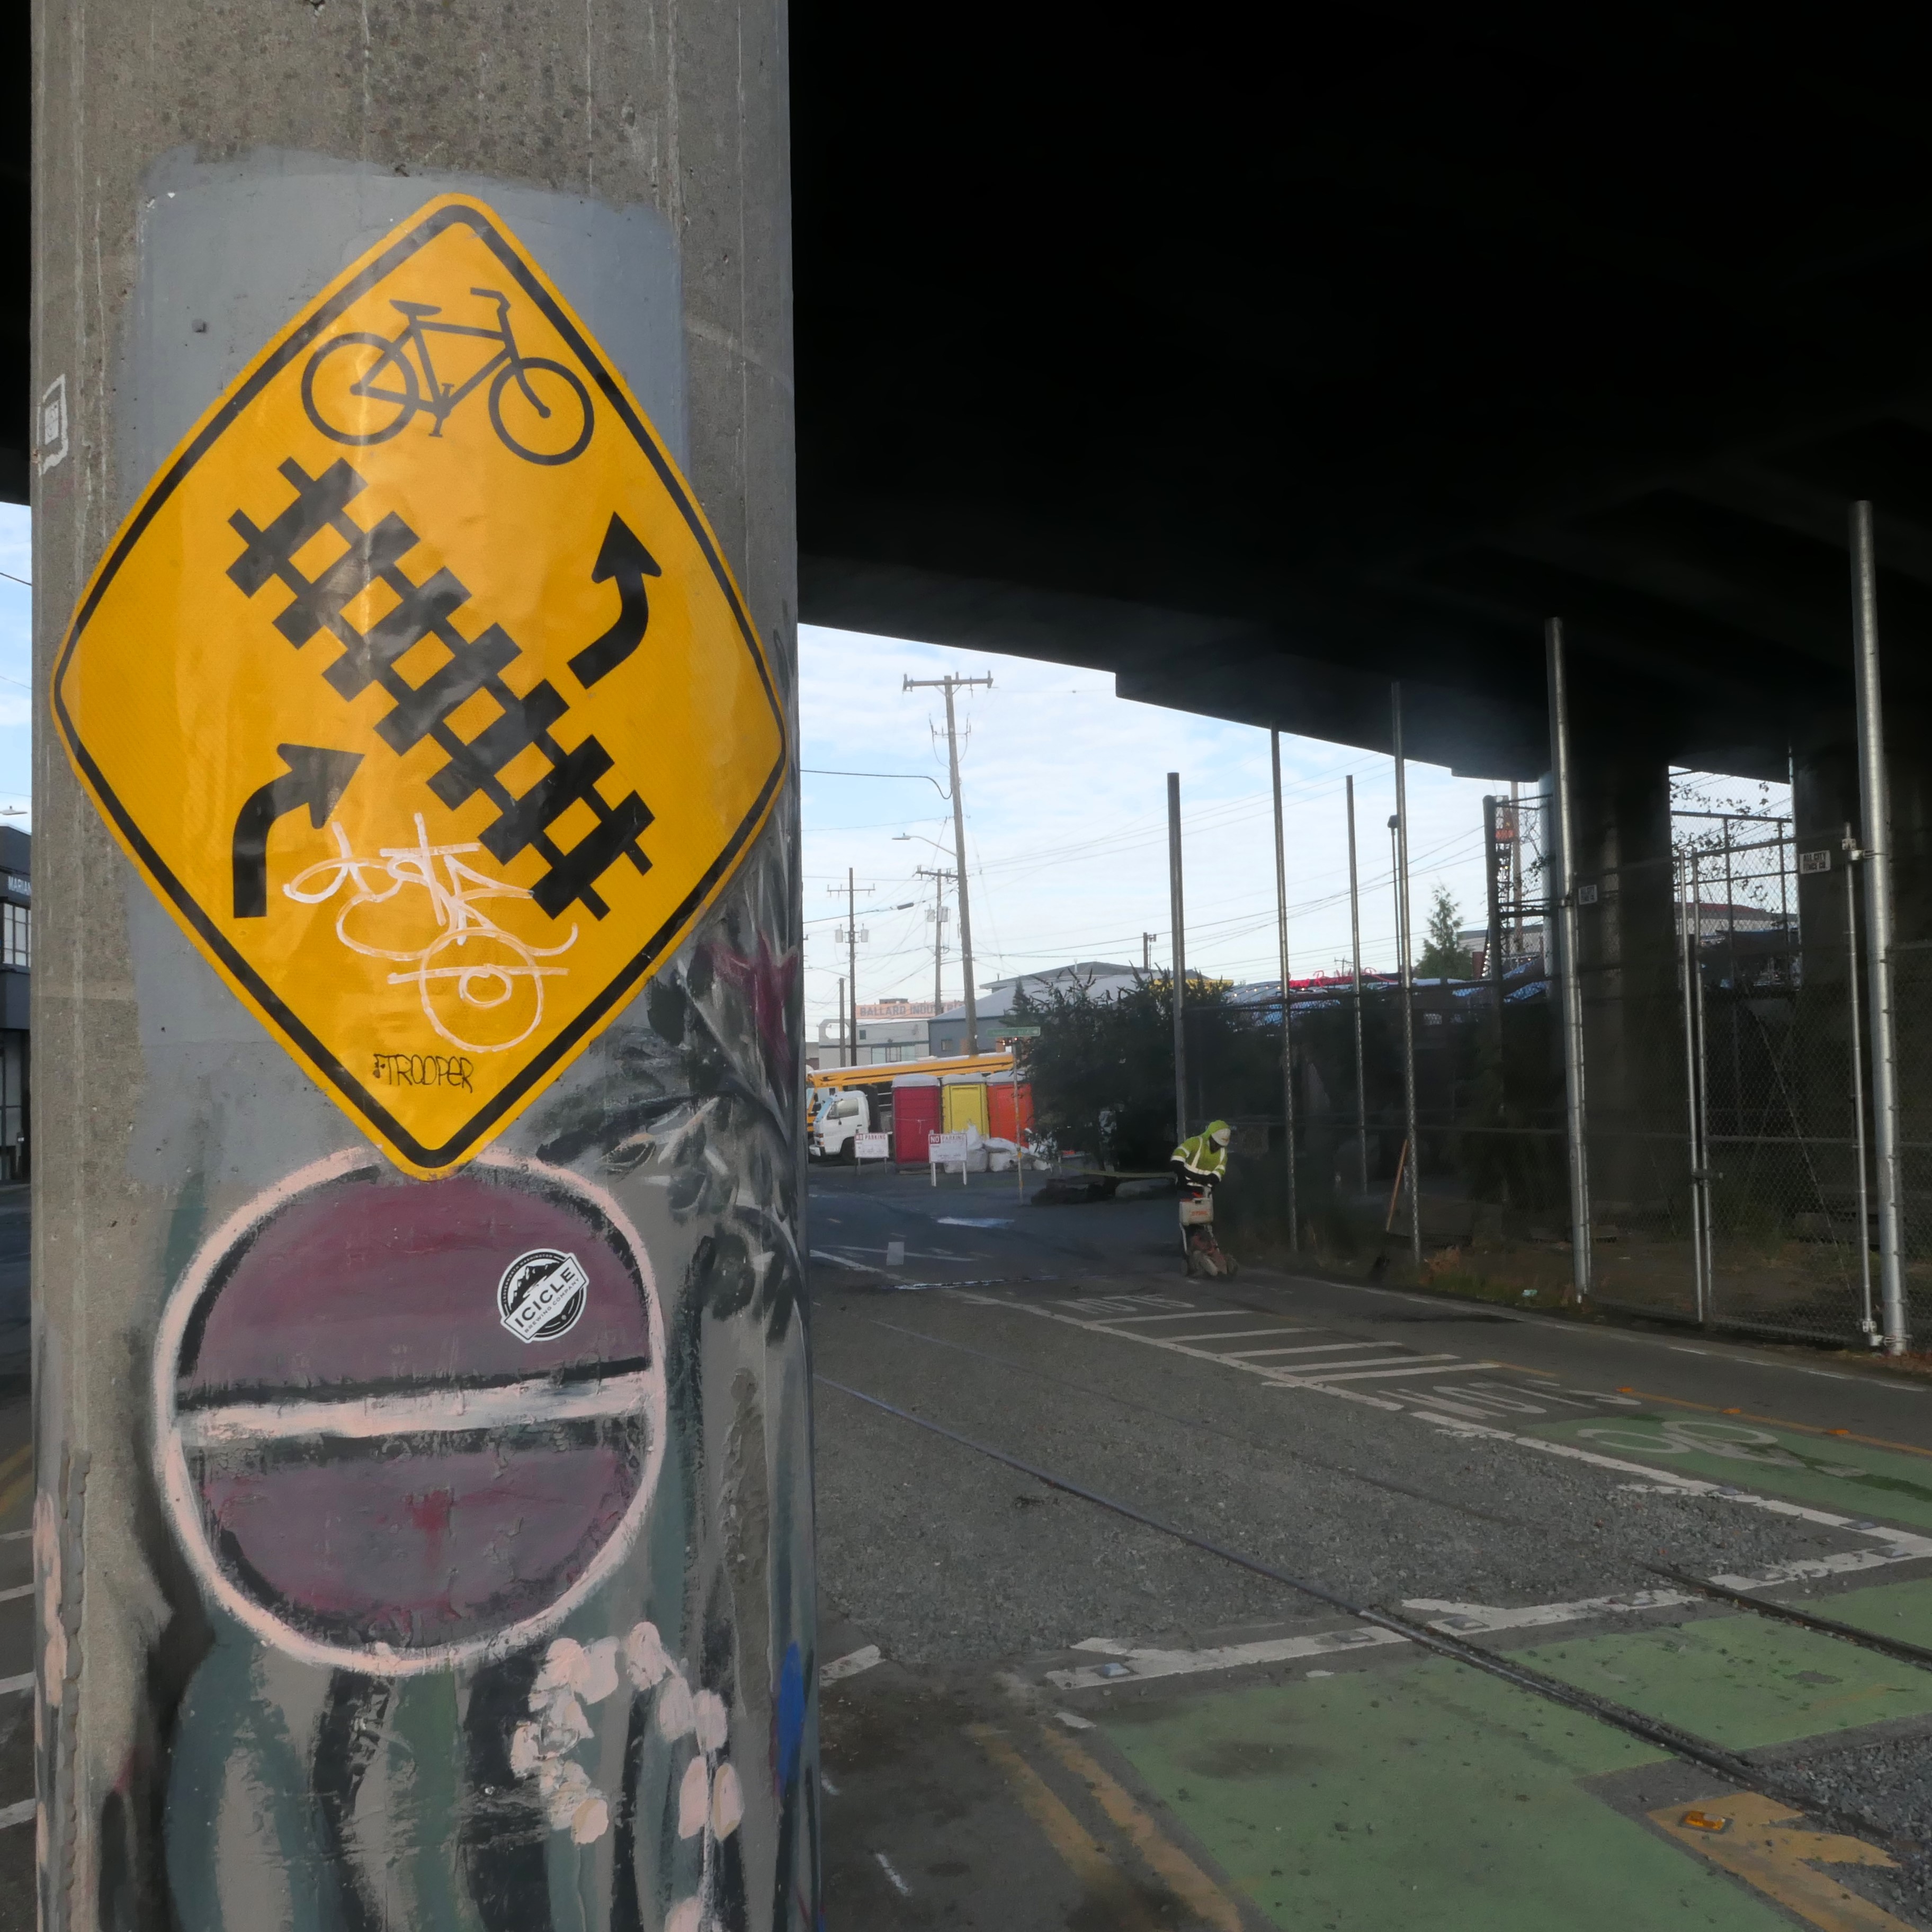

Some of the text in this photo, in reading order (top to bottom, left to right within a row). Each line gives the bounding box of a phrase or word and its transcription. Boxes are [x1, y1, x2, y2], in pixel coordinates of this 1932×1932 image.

[860, 1006, 906, 1016] BALLARD
[514, 1267, 576, 1328] ICICLE
[524, 1277, 579, 1333] BREWING COMPANY
